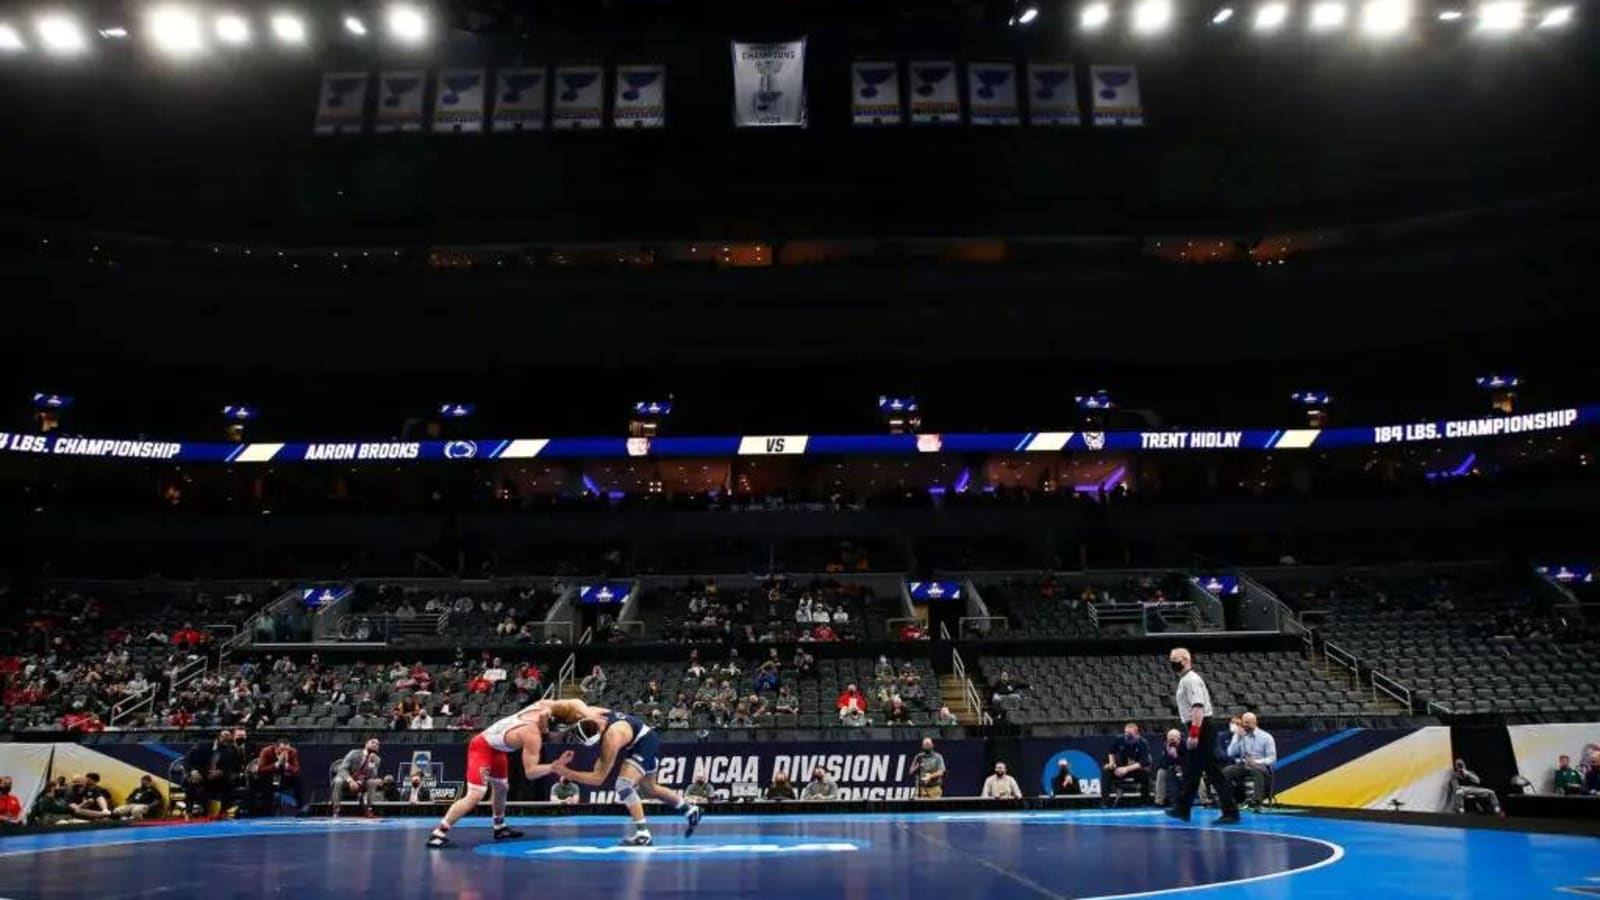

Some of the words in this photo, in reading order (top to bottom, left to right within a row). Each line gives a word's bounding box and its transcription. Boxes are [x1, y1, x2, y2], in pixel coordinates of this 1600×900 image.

[1374, 426, 1403, 443] 184
[1406, 423, 1441, 441] LBS.
[1446, 409, 1577, 438] CHAMPIONSHIP
[10, 434, 49, 452] LBS.
[54, 437, 181, 459] CHAMPIONSHIP
[766, 438, 785, 452] VS
[1140, 432, 1188, 448] TRENT
[1190, 431, 1243, 448] HIDLAY
[304, 443, 356, 460] AARON
[358, 442, 420, 459] BROOKS
[656, 757, 687, 784] 21
[693, 755, 759, 784] NCAA
[894, 754, 907, 782] I
